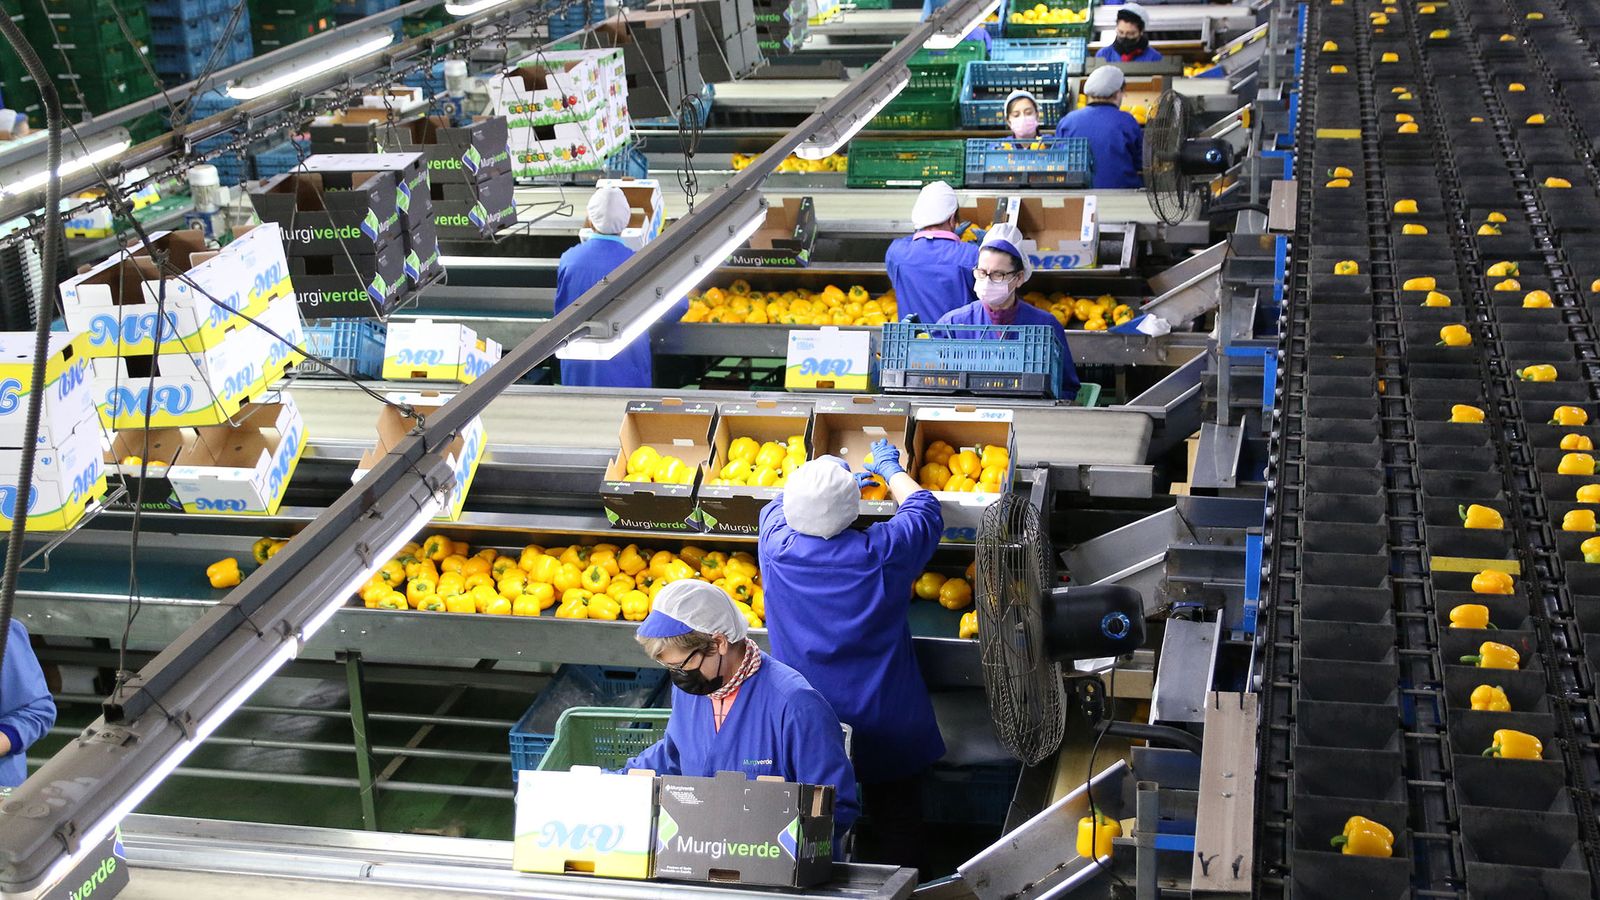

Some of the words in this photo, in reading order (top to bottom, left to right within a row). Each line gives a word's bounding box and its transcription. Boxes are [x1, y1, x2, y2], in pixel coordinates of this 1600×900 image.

[733, 255, 796, 266] Murgiverde
[255, 260, 282, 298] MV
[210, 291, 241, 329] MV
[296, 288, 368, 305] urgiverde
[88, 310, 178, 347] MV
[396, 347, 444, 366] MV
[799, 357, 853, 377] MV
[222, 362, 254, 401] MV
[105, 383, 193, 418] MV
[269, 425, 298, 499] MV
[73, 457, 98, 504] MV
[194, 497, 247, 512] MV
[620, 518, 687, 530] Murgiverde
[538, 820, 625, 852] MV
[677, 835, 781, 860] Murgiverde
